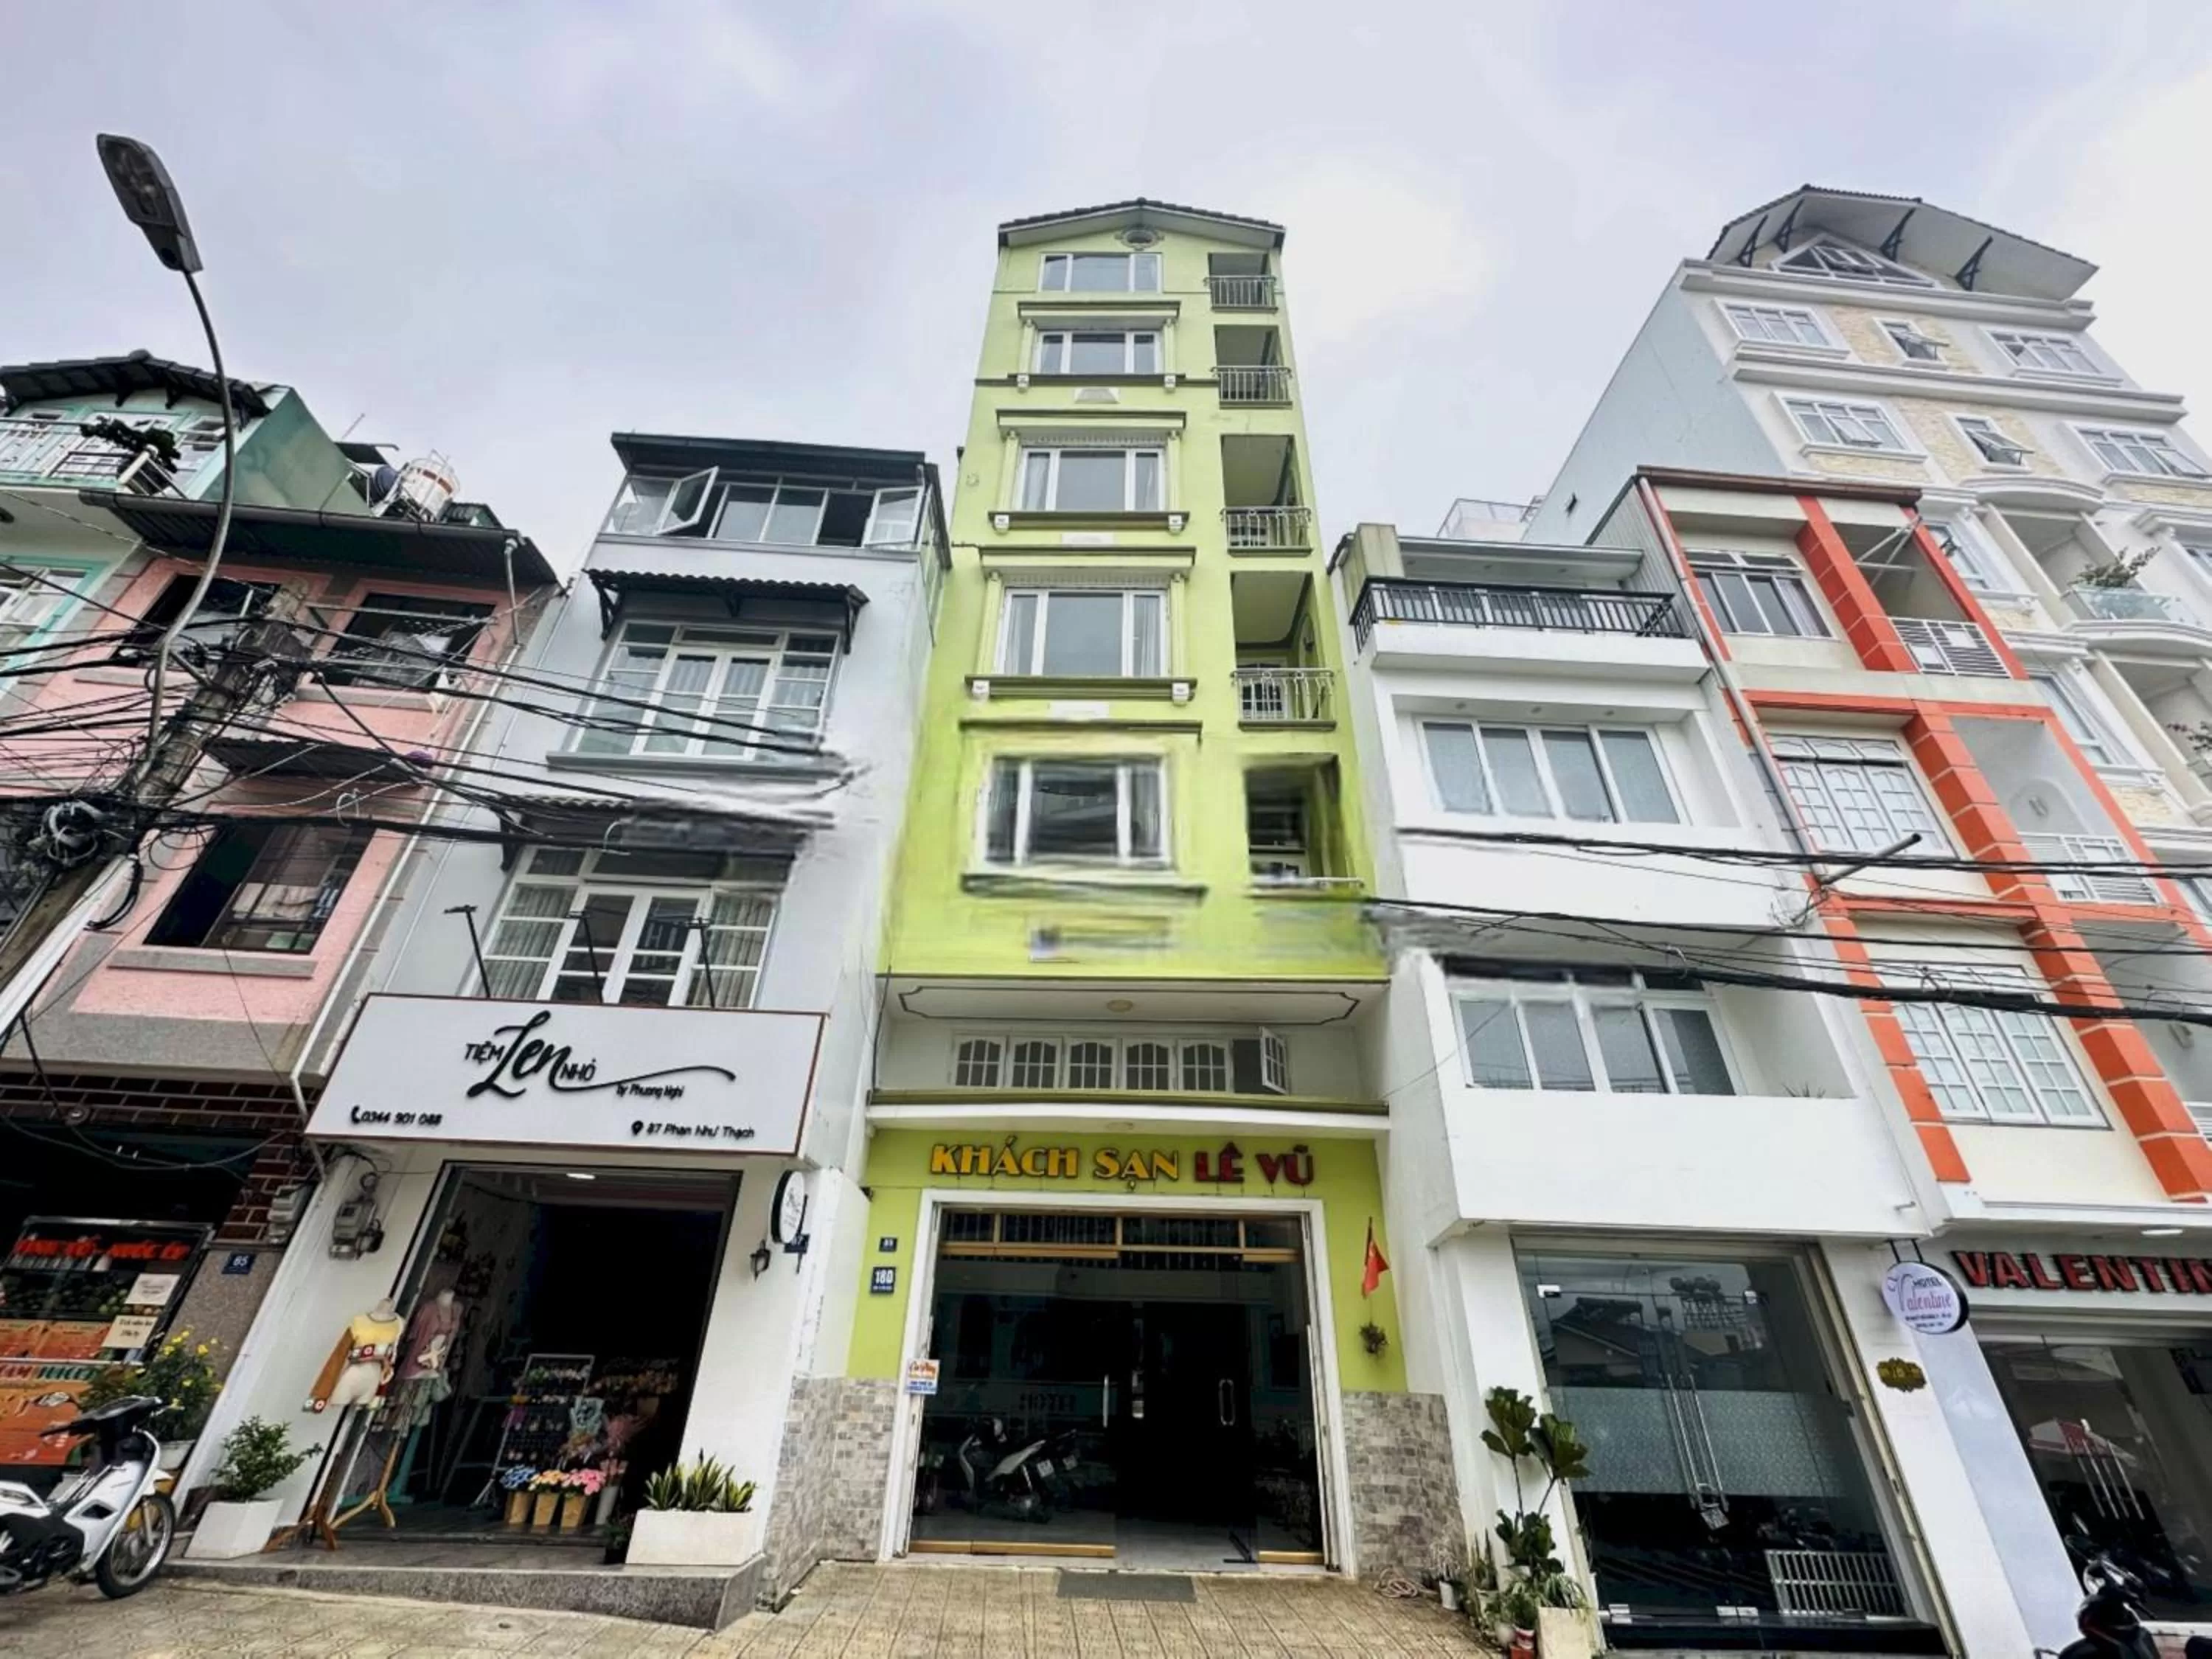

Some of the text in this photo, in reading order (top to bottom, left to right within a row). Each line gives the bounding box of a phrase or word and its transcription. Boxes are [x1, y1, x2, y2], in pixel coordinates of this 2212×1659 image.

[465, 1009, 609, 1099] TIỆM Len NHỎ
[664, 1123, 692, 1136] Phan
[931, 1135, 1315, 1190] KHÁCH SẠN LÊ VŨ
